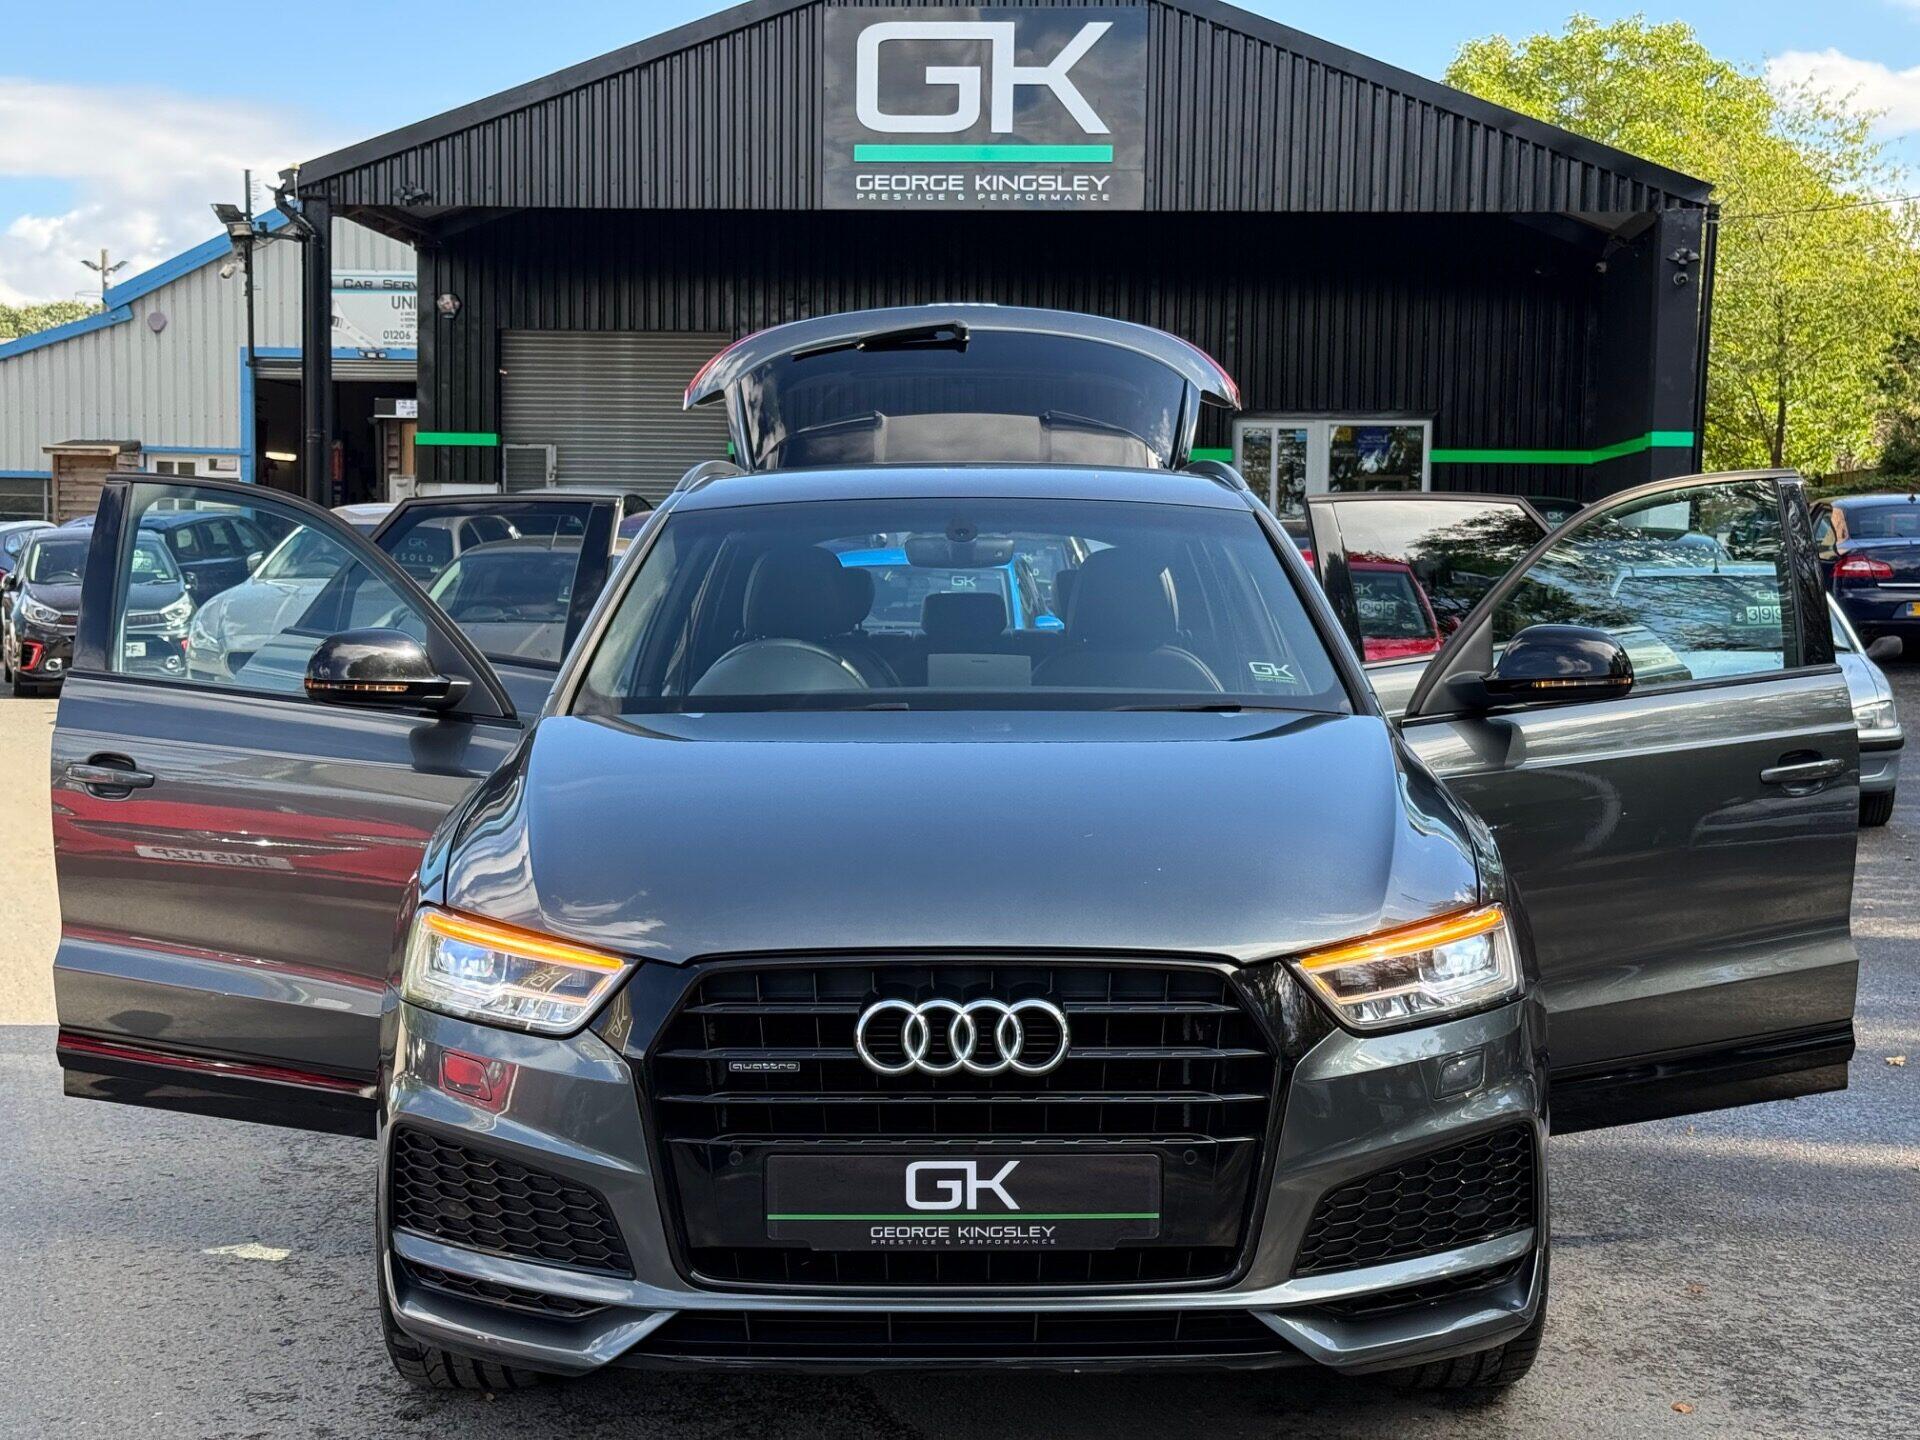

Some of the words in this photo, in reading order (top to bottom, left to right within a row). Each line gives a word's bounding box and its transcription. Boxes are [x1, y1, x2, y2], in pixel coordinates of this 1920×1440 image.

[856, 21, 1113, 134] GK
[855, 174, 965, 192] GEORGE
[974, 174, 1110, 192] KINGSLEY
[856, 193, 946, 201] PRESTIGE
[977, 193, 1110, 201] PERFORMANCE
[383, 330, 411, 340] 01206
[401, 553, 434, 562] SOLD
[951, 575, 977, 587] GK
[1248, 661, 1295, 677] GK
[732, 1062, 797, 1071] quattro
[905, 1160, 1021, 1211] GK
[870, 1226, 950, 1238] GEORGE
[957, 1226, 1056, 1238] KINGSLEY
